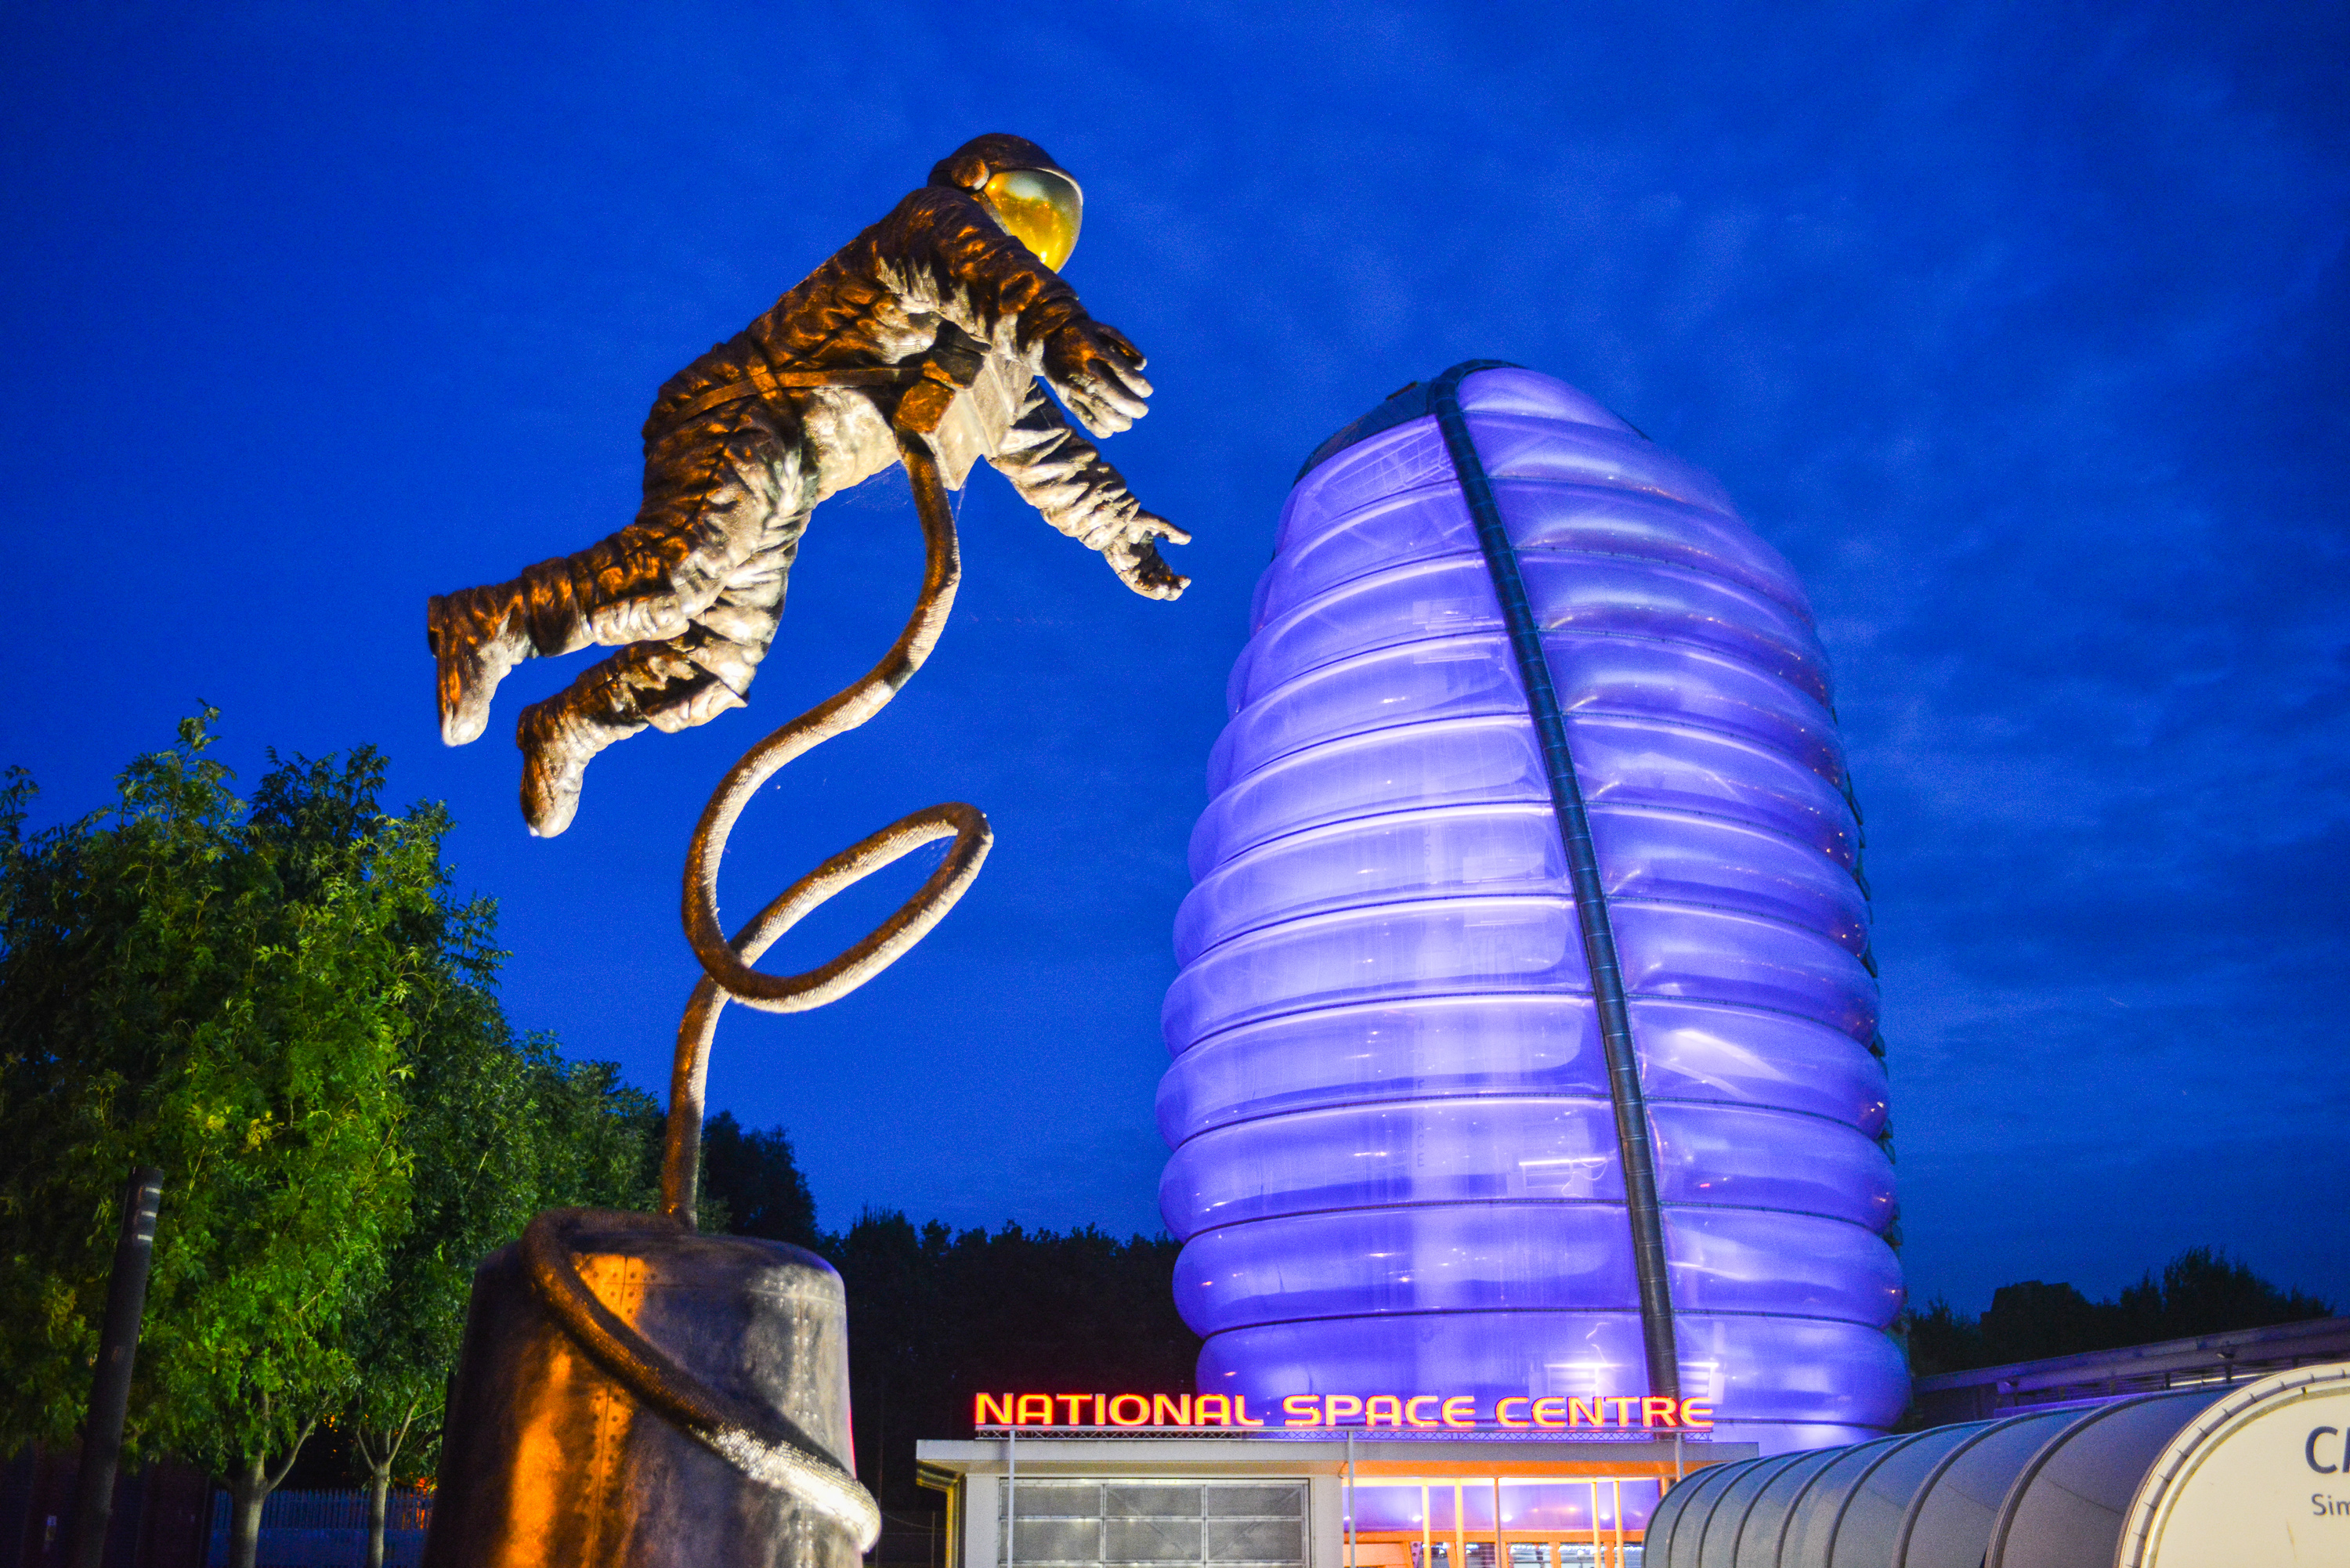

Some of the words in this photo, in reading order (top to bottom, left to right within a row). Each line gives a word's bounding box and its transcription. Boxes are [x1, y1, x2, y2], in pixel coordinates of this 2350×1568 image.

[974, 1393, 1264, 1426] NATIONAL
[1282, 1394, 1476, 1427] SPACE
[1495, 1396, 1714, 1427] CENTRE
